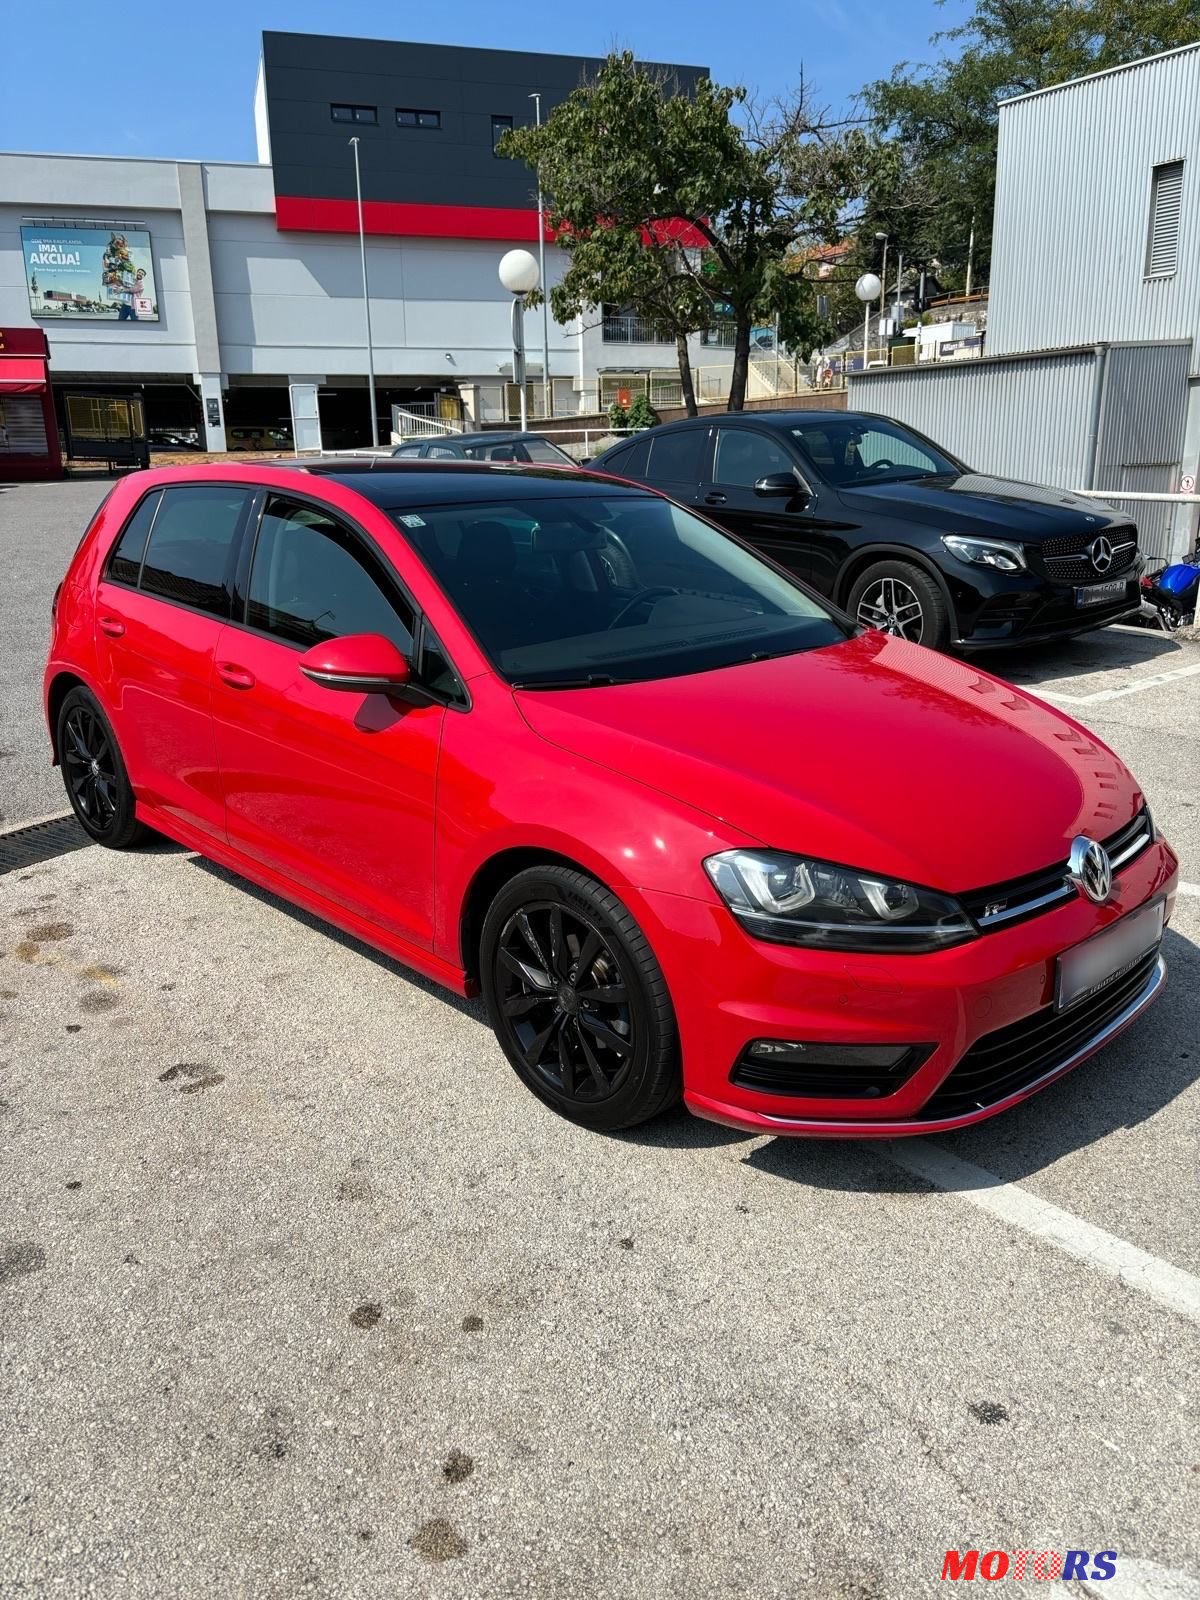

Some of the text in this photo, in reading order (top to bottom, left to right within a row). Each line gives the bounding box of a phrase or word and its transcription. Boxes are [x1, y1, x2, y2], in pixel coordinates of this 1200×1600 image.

[38, 244, 63, 253] IMA I
[30, 251, 80, 265] AKCIJA!
